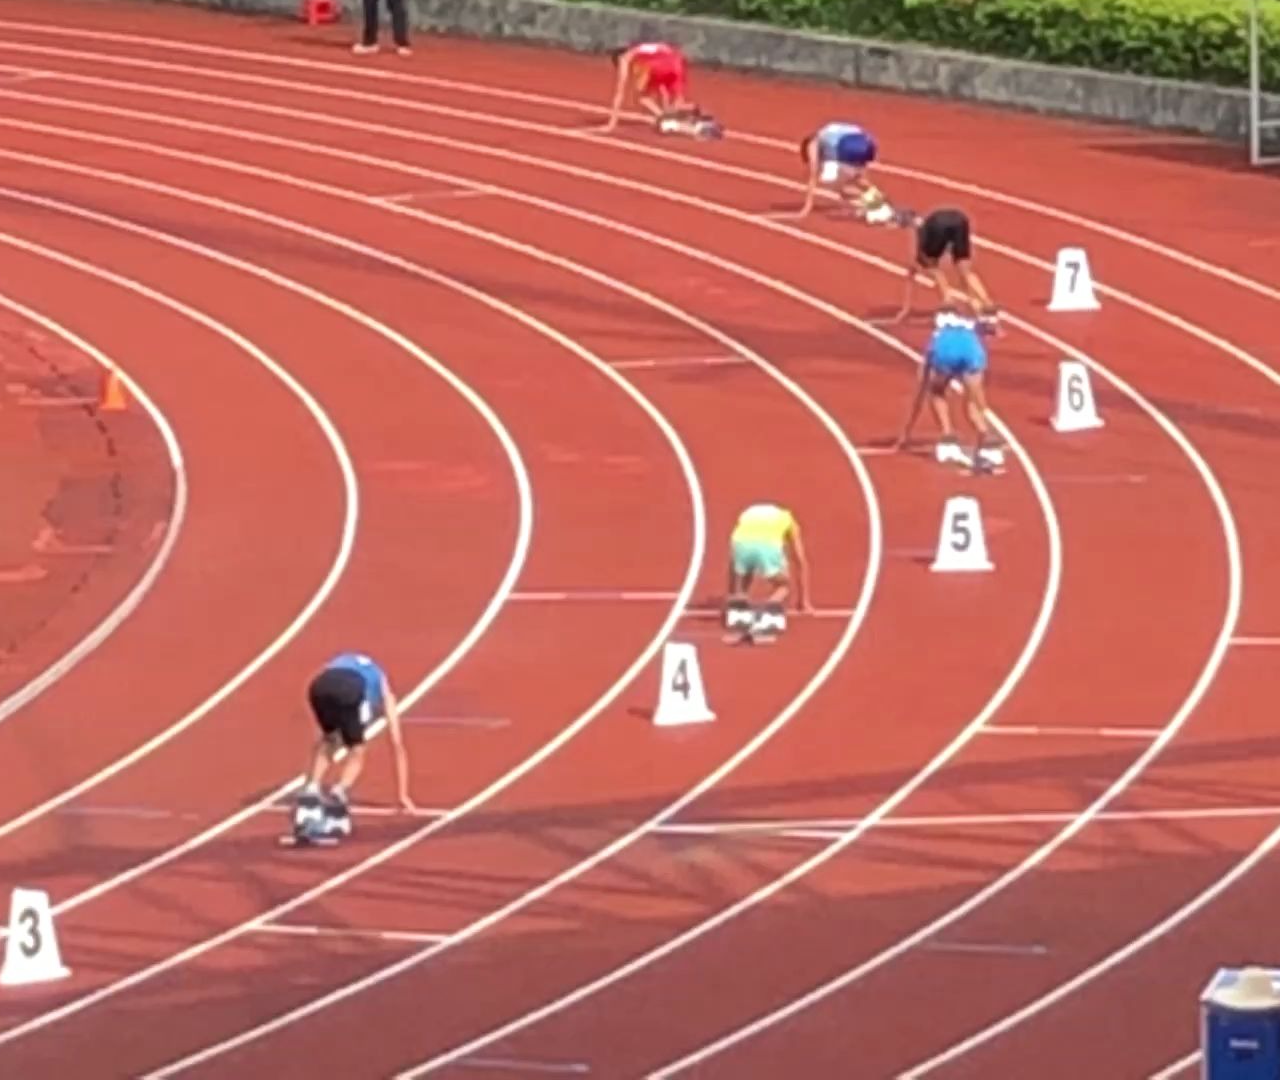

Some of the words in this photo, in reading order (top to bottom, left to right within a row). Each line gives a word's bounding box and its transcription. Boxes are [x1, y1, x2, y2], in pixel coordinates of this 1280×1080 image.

[1065, 262, 1080, 293] 7
[1067, 375, 1085, 411] 6
[951, 512, 971, 552] 5
[671, 658, 691, 700] 4
[18, 907, 43, 958] 3
